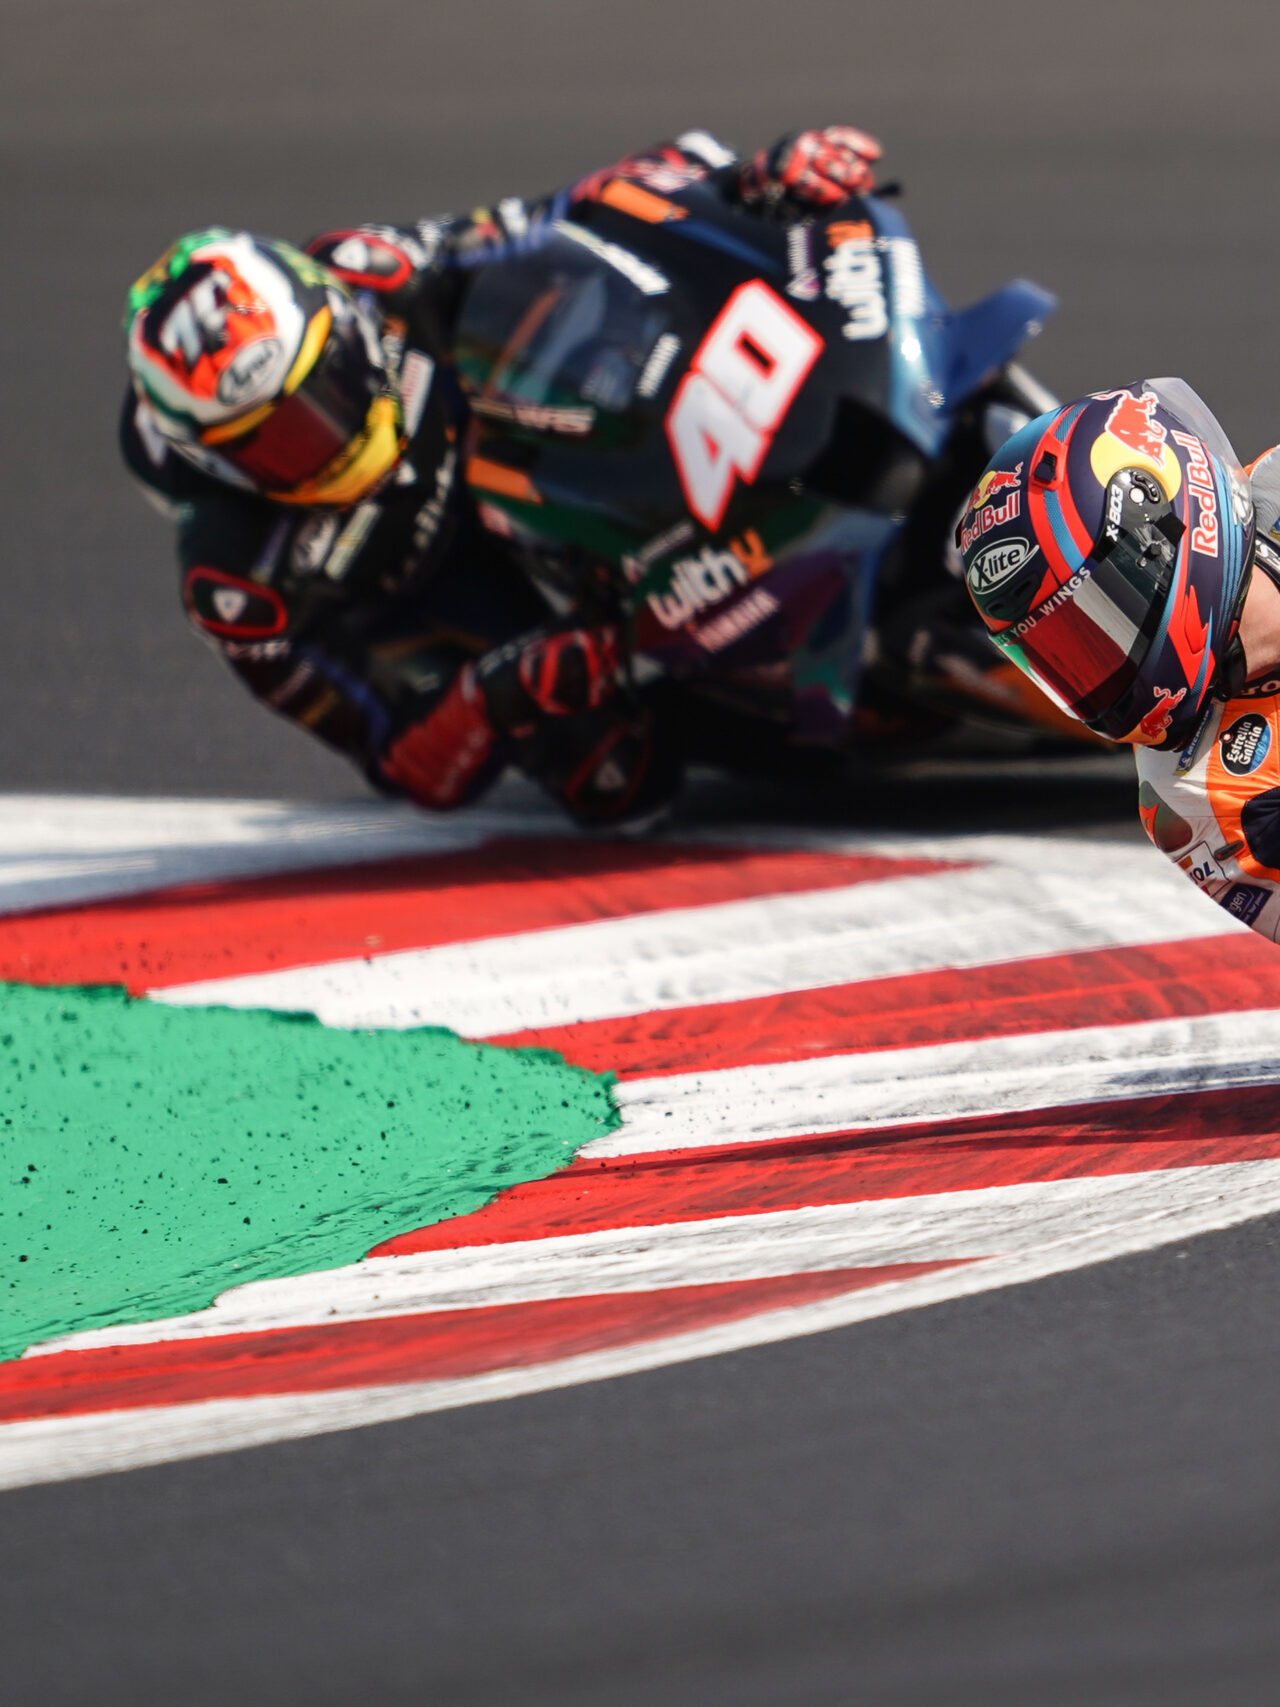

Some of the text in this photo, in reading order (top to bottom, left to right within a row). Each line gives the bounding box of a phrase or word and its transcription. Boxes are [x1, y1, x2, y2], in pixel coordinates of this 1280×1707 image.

[664, 277, 827, 532] 40
[1106, 484, 1124, 542] X-803
[972, 549, 1021, 594] X-lite
[1010, 566, 1091, 638] YOU WINGS
[1226, 721, 1252, 763] Estrella
[1238, 726, 1263, 765] Galicia
